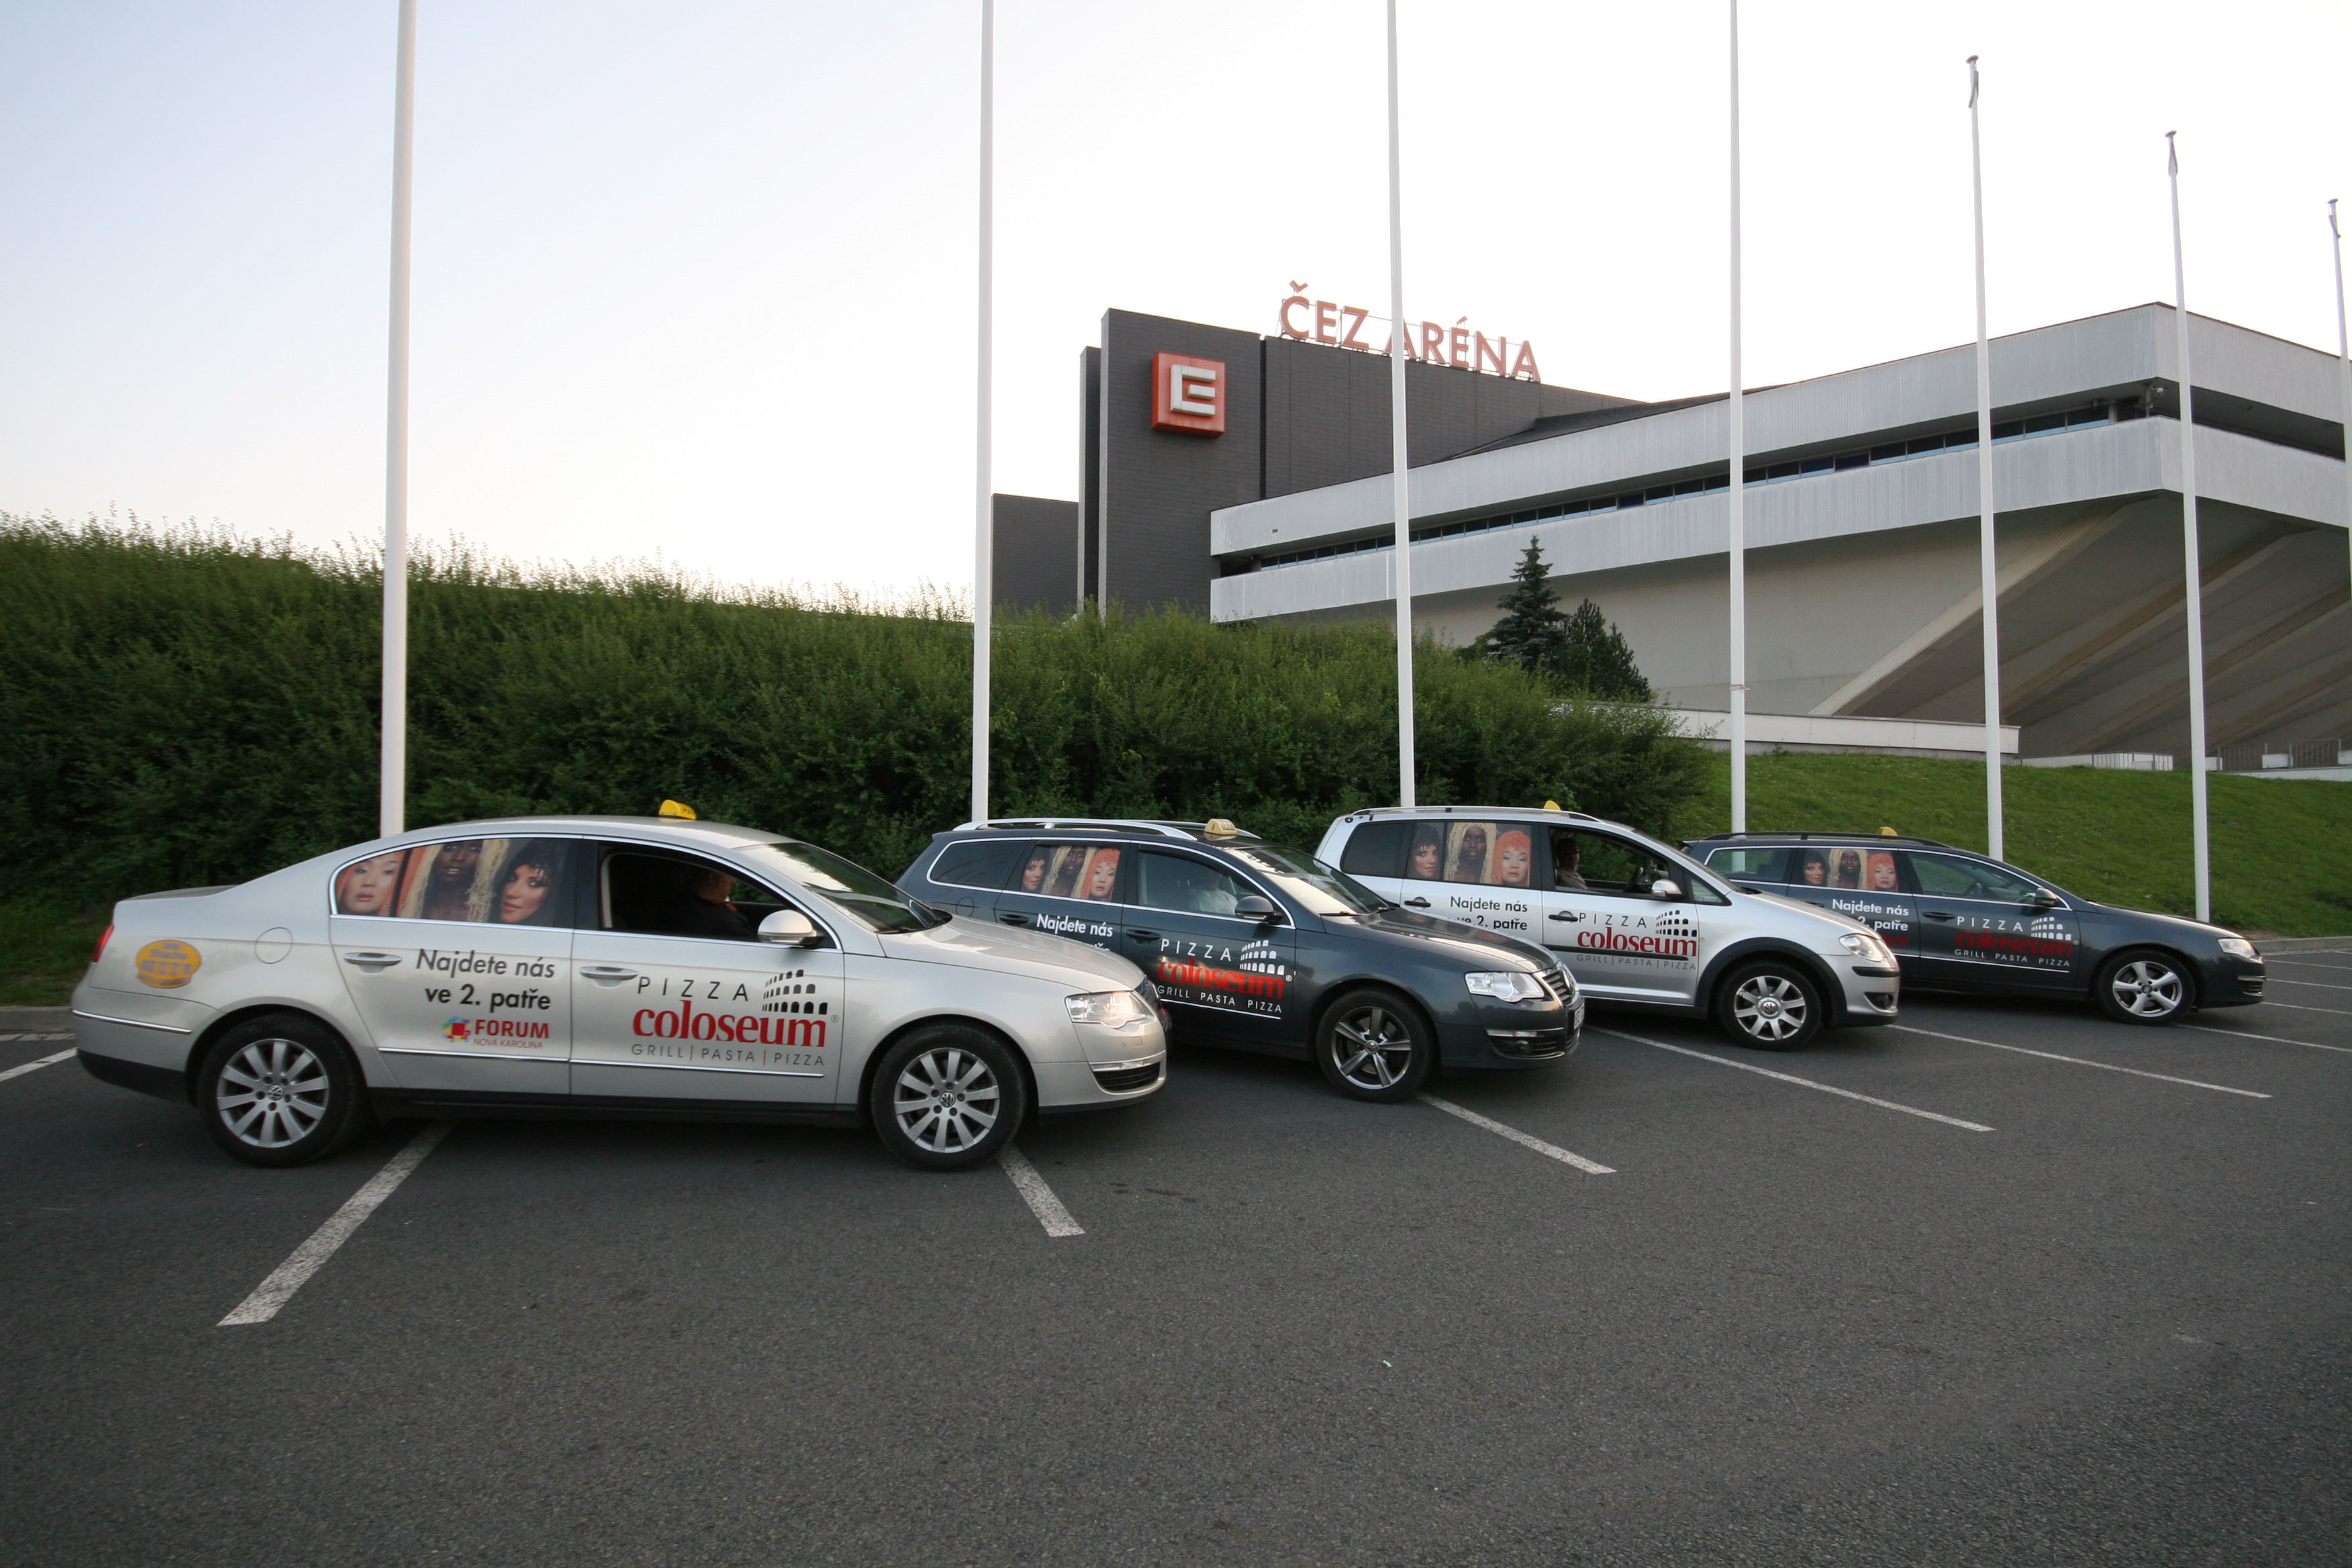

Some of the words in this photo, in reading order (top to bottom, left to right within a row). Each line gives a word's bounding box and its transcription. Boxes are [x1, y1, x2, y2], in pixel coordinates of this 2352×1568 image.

[1279, 279, 1369, 350] ČEZ
[1383, 315, 1541, 383] ARÉNA
[1450, 895, 1501, 912] Najdete
[1505, 900, 1528, 912] nás
[1832, 899, 1882, 914] Najdete
[1886, 905, 1909, 916] nás
[1036, 913, 1087, 934] Najdete
[1089, 922, 1114, 937] nás
[1493, 918, 1528, 930] patře
[1579, 912, 1647, 928] PIZZA
[1874, 919, 1908, 931] patře
[1957, 916, 2024, 932] PIZZA
[1161, 938, 1232, 962] PIZZA
[1577, 926, 1697, 957] coloseum
[1955, 929, 2073, 957] coloseum
[415, 948, 507, 978] Najdete
[515, 957, 555, 978] nás
[1577, 954, 1608, 963] GRILL
[1618, 958, 1652, 967] PASTA
[1664, 961, 1696, 970] PIZZA
[1954, 949, 1985, 959] GRILL
[1995, 953, 2028, 963] PASTA
[2039, 958, 2070, 967] PIZZA
[637, 976, 748, 1001] PIZZA
[1157, 957, 1285, 999] coloseum
[425, 988, 452, 1003] ve
[459, 983, 481, 1006] 2.
[489, 988, 551, 1013] patře
[1157, 985, 1189, 998] GRILL
[1200, 992, 1236, 1006] PASTA
[1247, 999, 1282, 1014] PIZZA
[474, 1019, 549, 1038] FORUM
[632, 999, 826, 1047] coloseum
[473, 1038, 497, 1046] NOVÁ
[499, 1040, 543, 1048] KAROLINA
[631, 1044, 684, 1058] GRILL
[701, 1048, 755, 1061] PASTA
[774, 1052, 824, 1066] PIZZA
